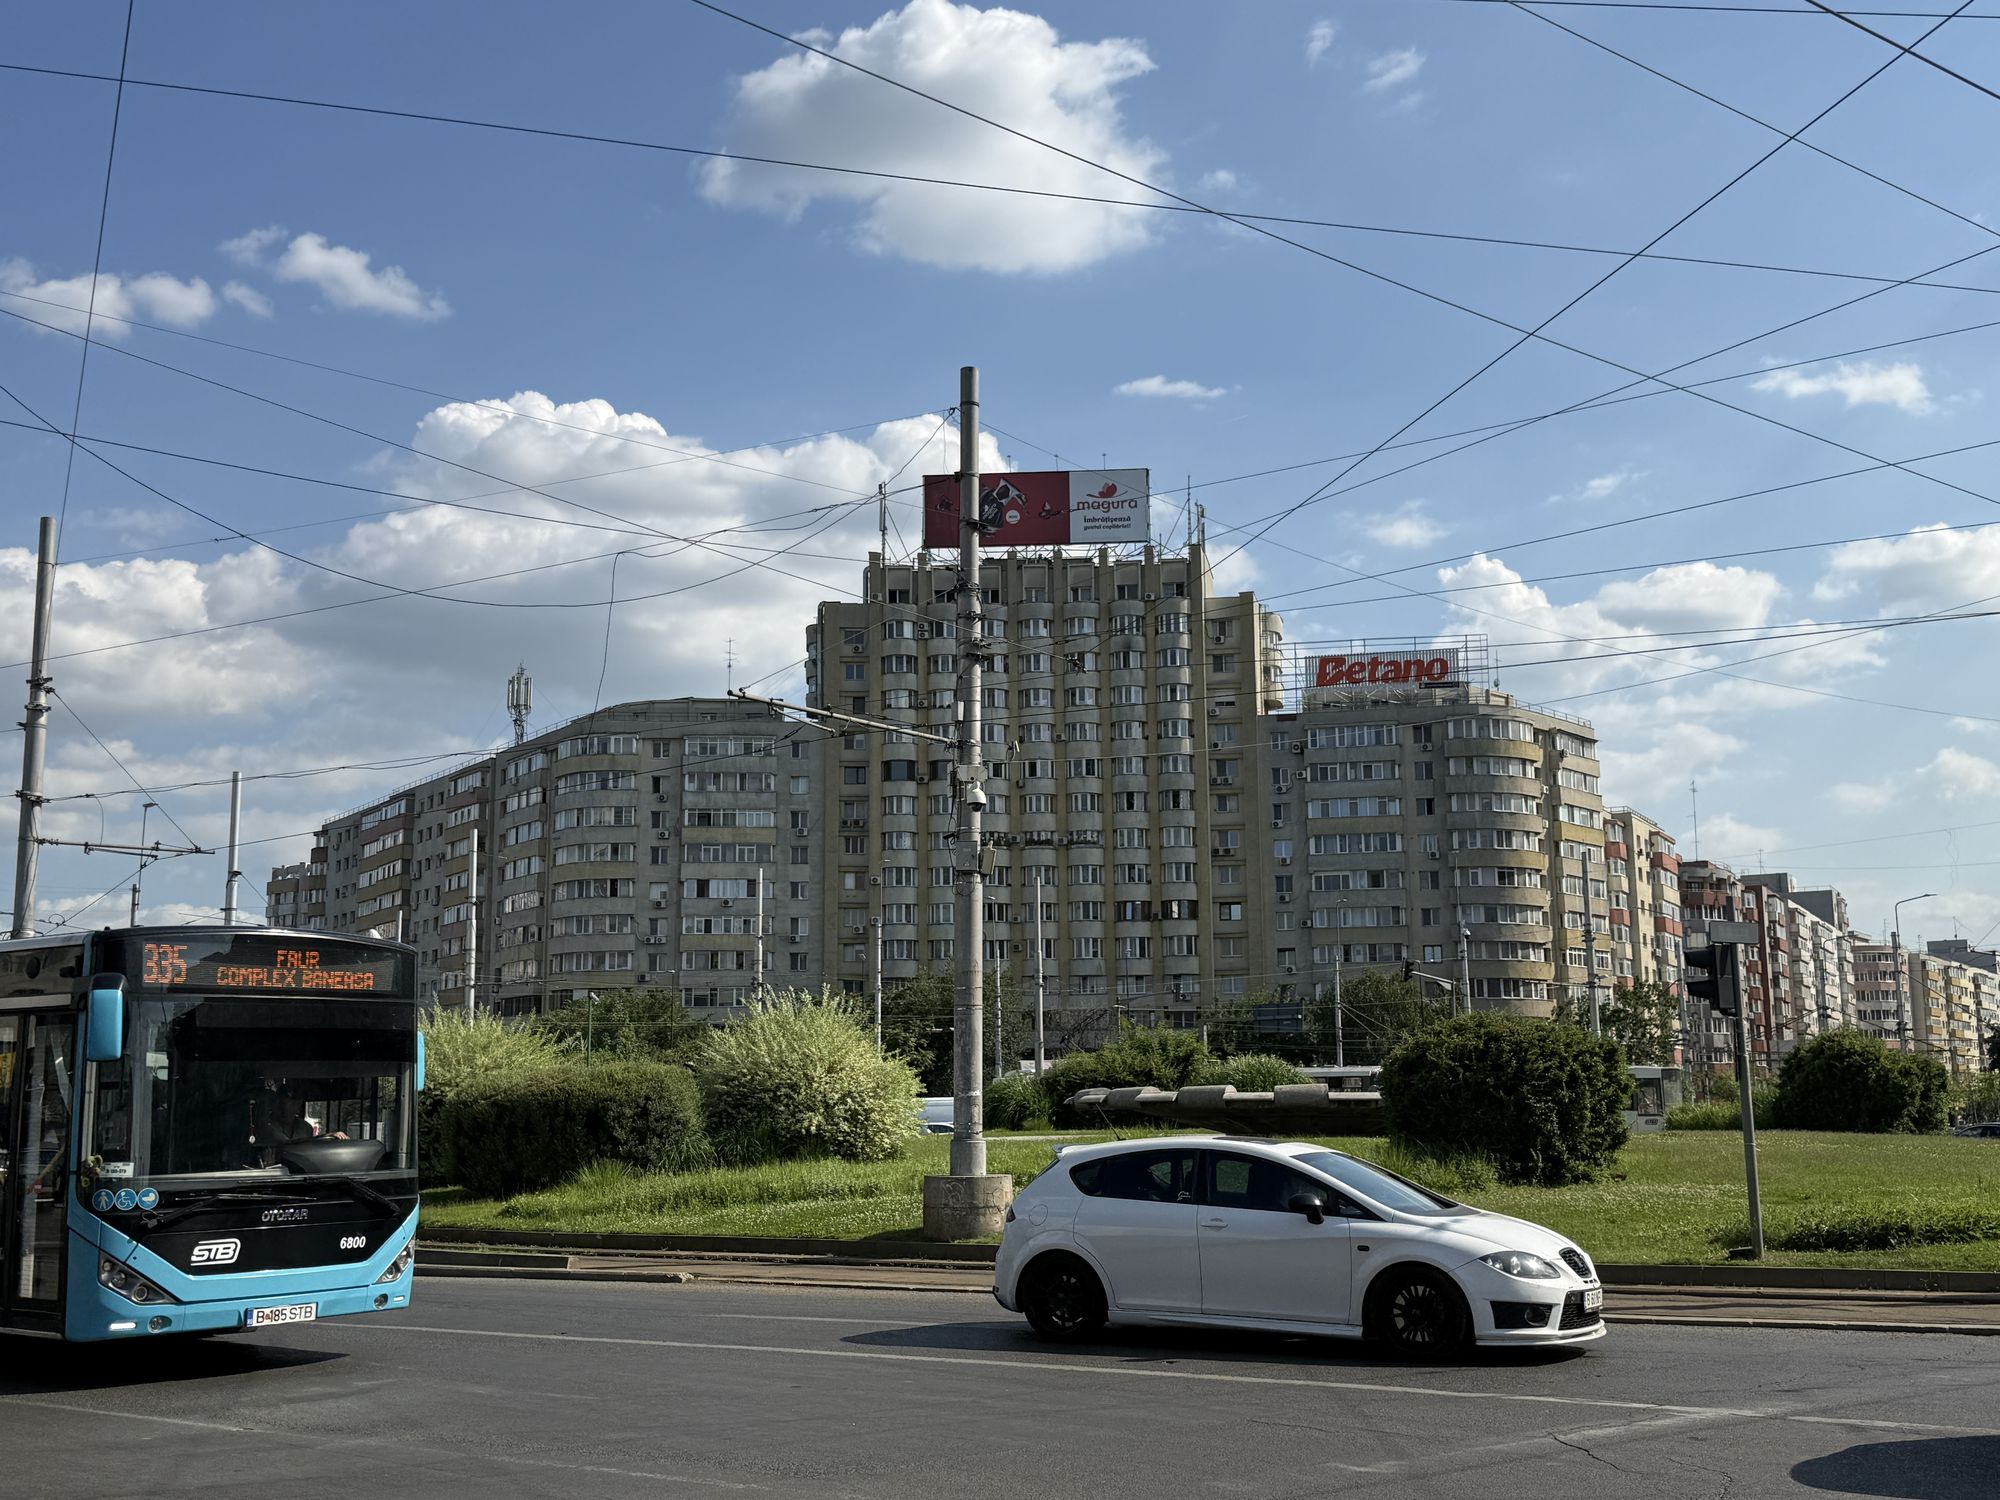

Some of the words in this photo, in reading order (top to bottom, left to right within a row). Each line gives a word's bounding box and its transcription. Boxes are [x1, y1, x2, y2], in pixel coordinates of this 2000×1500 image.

[1076, 499, 1138, 513] magura
[1316, 656, 1449, 687] Betano
[143, 943, 188, 984] 335
[276, 950, 320, 969] FAUR
[216, 966, 297, 988] COMPLEX
[302, 970, 375, 990] BANEASA
[261, 1208, 309, 1222] OTOKAR
[190, 1240, 239, 1263] STB
[340, 1235, 367, 1249] 6800
[270, 1308, 287, 1322] 185
